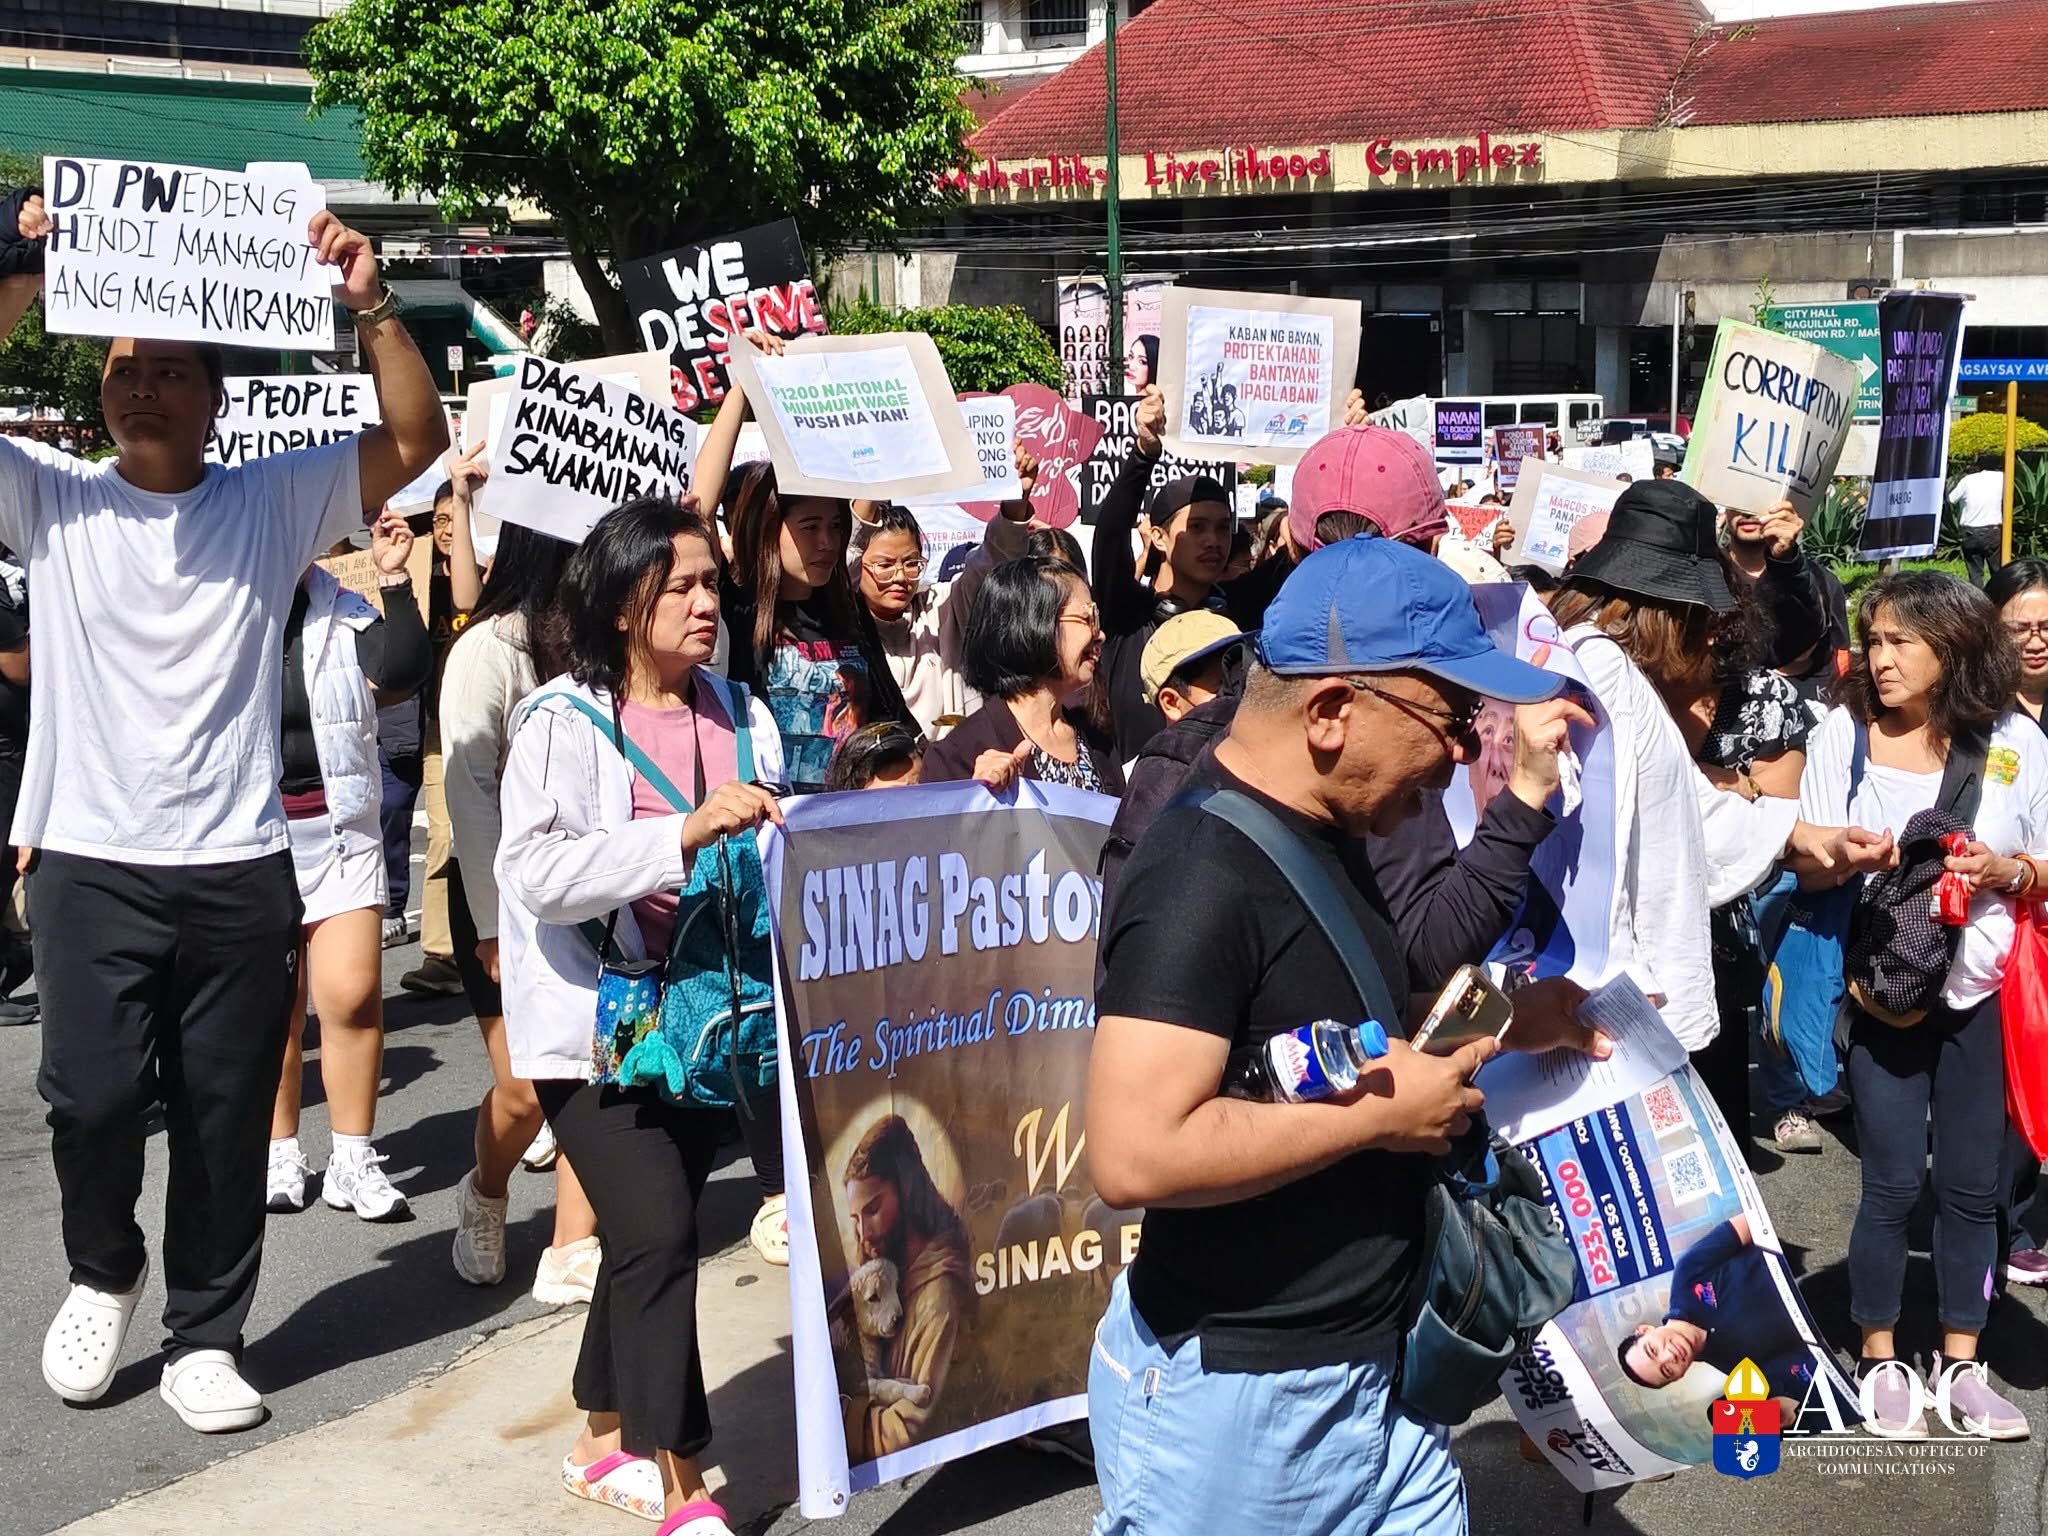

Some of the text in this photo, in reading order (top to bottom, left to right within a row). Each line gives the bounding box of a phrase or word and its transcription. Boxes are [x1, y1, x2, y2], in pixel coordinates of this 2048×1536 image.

[1144, 144, 1332, 186] Livelihood
[1365, 130, 1542, 184] Complex
[52, 159, 297, 224] DI PWEDENG
[50, 213, 321, 281] HINDI MANAGOT
[662, 241, 749, 303] WE
[51, 265, 121, 313] ANG
[638, 279, 829, 353] DESERVE
[1784, 308, 1838, 319] CITY HALL
[1784, 318, 1861, 329] NAGUILIAN RD.
[1229, 326, 1323, 346] KABAN NG BAYAN,
[1831, 329, 1848, 338] RD.
[1224, 342, 1320, 364] PROTEKTAHAN!
[521, 357, 613, 417] DAGA,
[1250, 364, 1319, 384] BANTAYAN!
[822, 378, 907, 398] NATIONAL
[1240, 383, 1319, 404] IPAGLABAN!
[1724, 351, 1850, 431] CORRUPTION
[782, 393, 910, 415] MINIMUM WAGE
[794, 408, 910, 429] PUSH NA YAN!
[966, 414, 1004, 429] IPINO
[1373, 408, 1407, 430] AN
[515, 397, 689, 489] KINABAKNANG
[977, 431, 1005, 445] NYO
[1732, 412, 1828, 490] KILLS
[505, 433, 687, 503] SALAKNIB
[978, 448, 1006, 462] ONG
[1549, 496, 1588, 514] MARCOS
[951, 530, 976, 540] AGAIN
[800, 856, 929, 981] SINAG
[801, 1020, 860, 1079] The
[869, 988, 1002, 1080] Spiritual
[1574, 1118, 1590, 1145] FOR
[1618, 1142, 1643, 1198] PRIBADO,
[1603, 1203, 1619, 1226] SG
[1637, 1198, 1649, 1216] SA
[1611, 1227, 1629, 1260] FOR
[1642, 1216, 1663, 1268] SWELDO
[974, 1230, 1103, 1296] SINAG
[1531, 1340, 1574, 1401] NOW!
